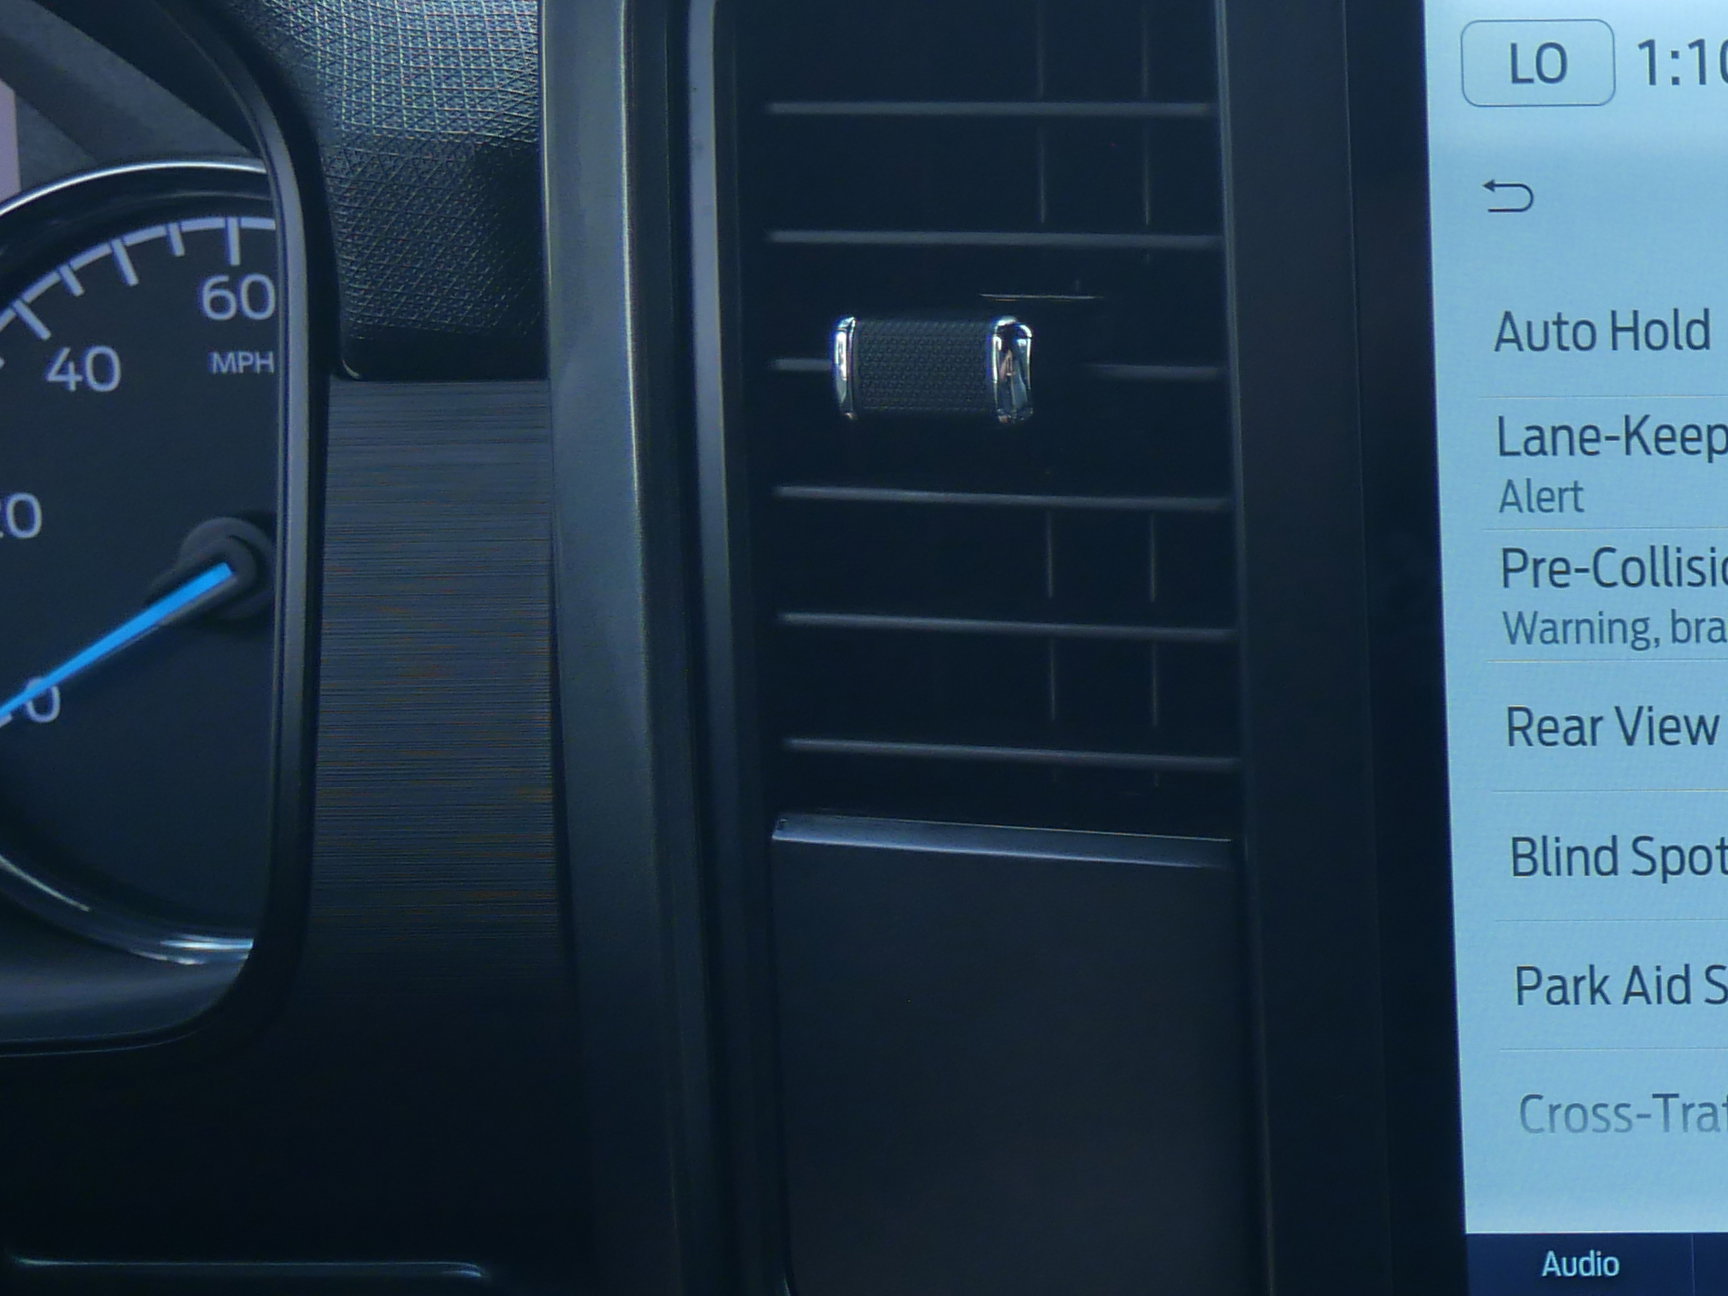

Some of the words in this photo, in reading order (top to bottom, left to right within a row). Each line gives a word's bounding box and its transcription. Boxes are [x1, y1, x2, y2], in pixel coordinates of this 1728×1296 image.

[1510, 41, 1568, 85] LO
[201, 273, 276, 321] 60
[1493, 310, 1597, 353] Auto
[1610, 307, 1711, 352] Hold
[45, 345, 121, 392] 40
[210, 350, 275, 377] MPH
[0, 492, 44, 540] 0
[1498, 477, 1585, 514] Alert
[1501, 610, 1661, 652] Warning,
[1507, 704, 1604, 748] Rear
[1613, 705, 1721, 747] View
[1511, 834, 1619, 878] Blind
[1515, 963, 1612, 1006] Park
[1622, 963, 1692, 1006] Aid
[1541, 1249, 1621, 1278] Audio
